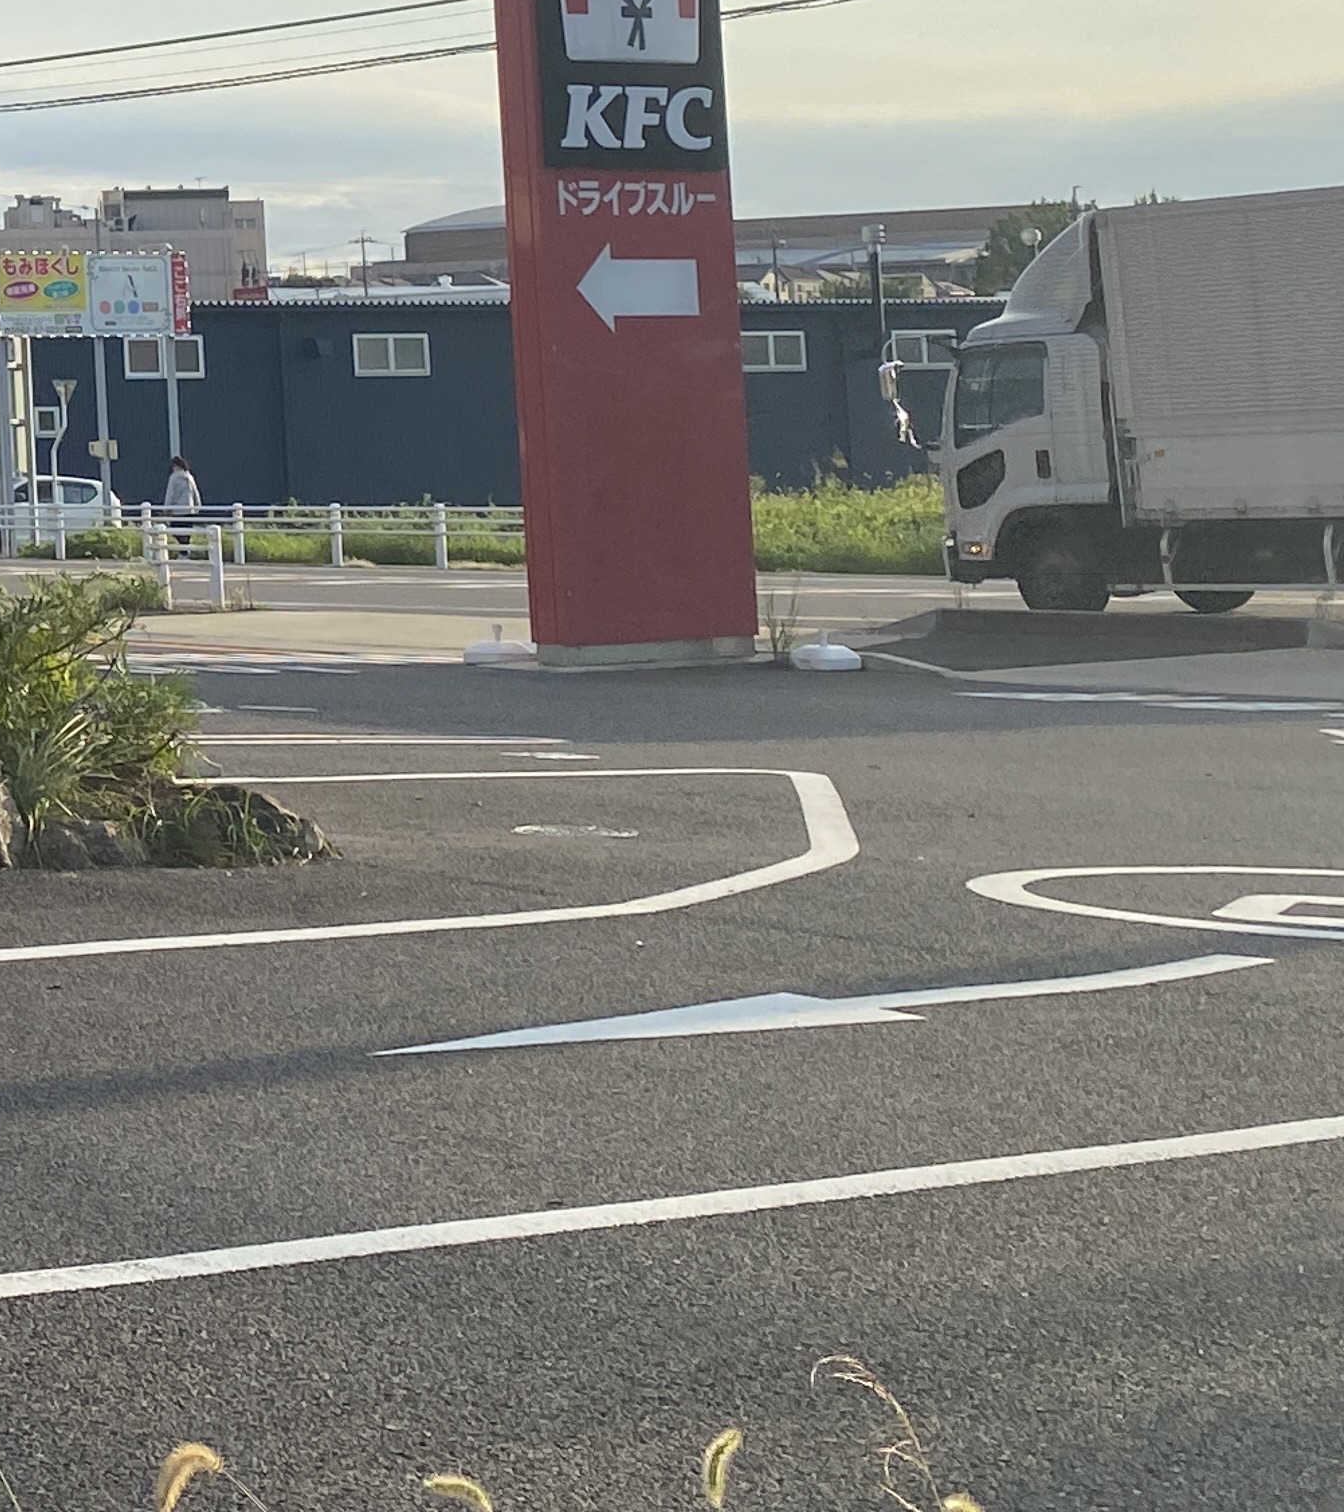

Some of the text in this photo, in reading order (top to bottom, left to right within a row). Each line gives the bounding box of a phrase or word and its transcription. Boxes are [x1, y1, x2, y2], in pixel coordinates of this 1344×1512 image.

[561, 85, 713, 151] KFC
[558, 179, 717, 216] ドライブスルー
